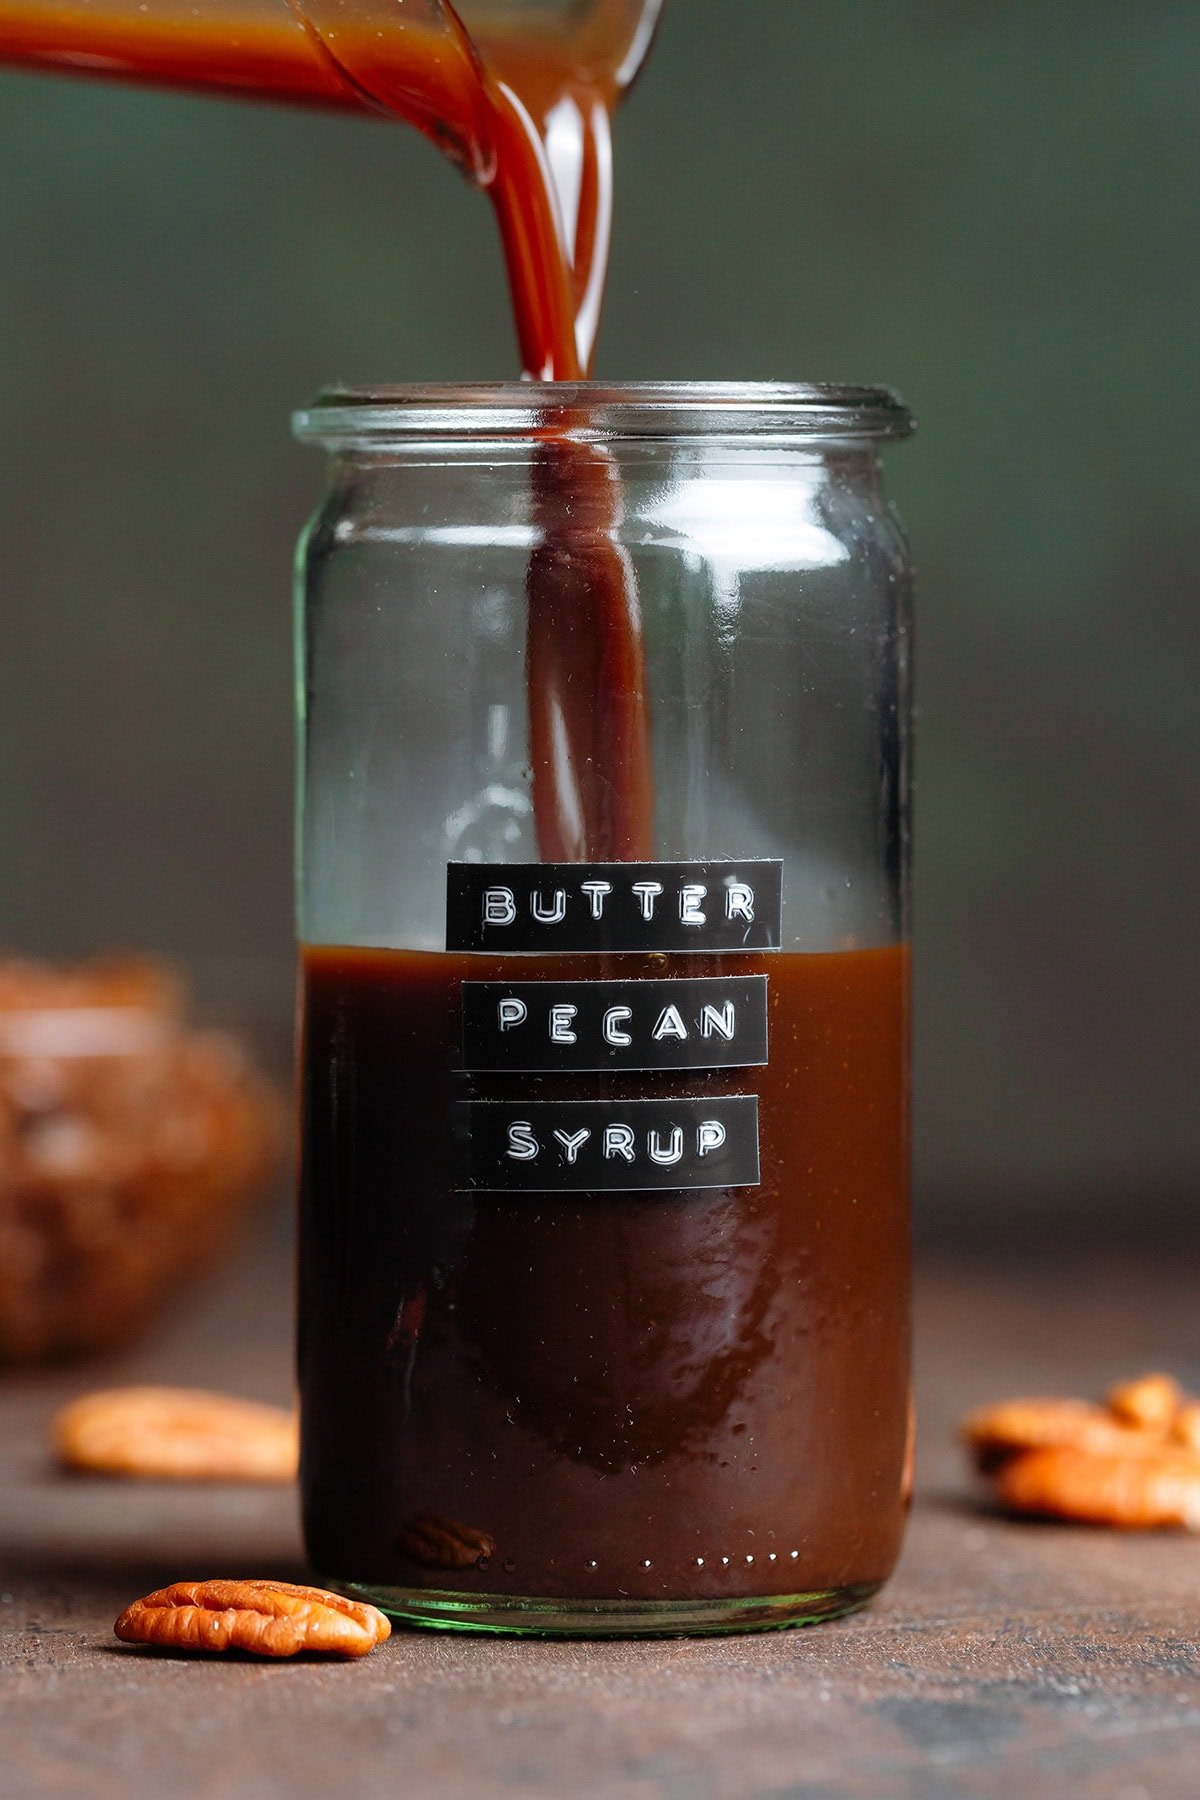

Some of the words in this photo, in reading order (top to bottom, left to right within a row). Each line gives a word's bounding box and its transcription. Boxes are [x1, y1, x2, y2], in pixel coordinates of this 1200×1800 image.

[483, 881, 754, 926] BUTTER
[498, 998, 735, 1046] PECAN
[506, 1120, 726, 1165] SYRUP
